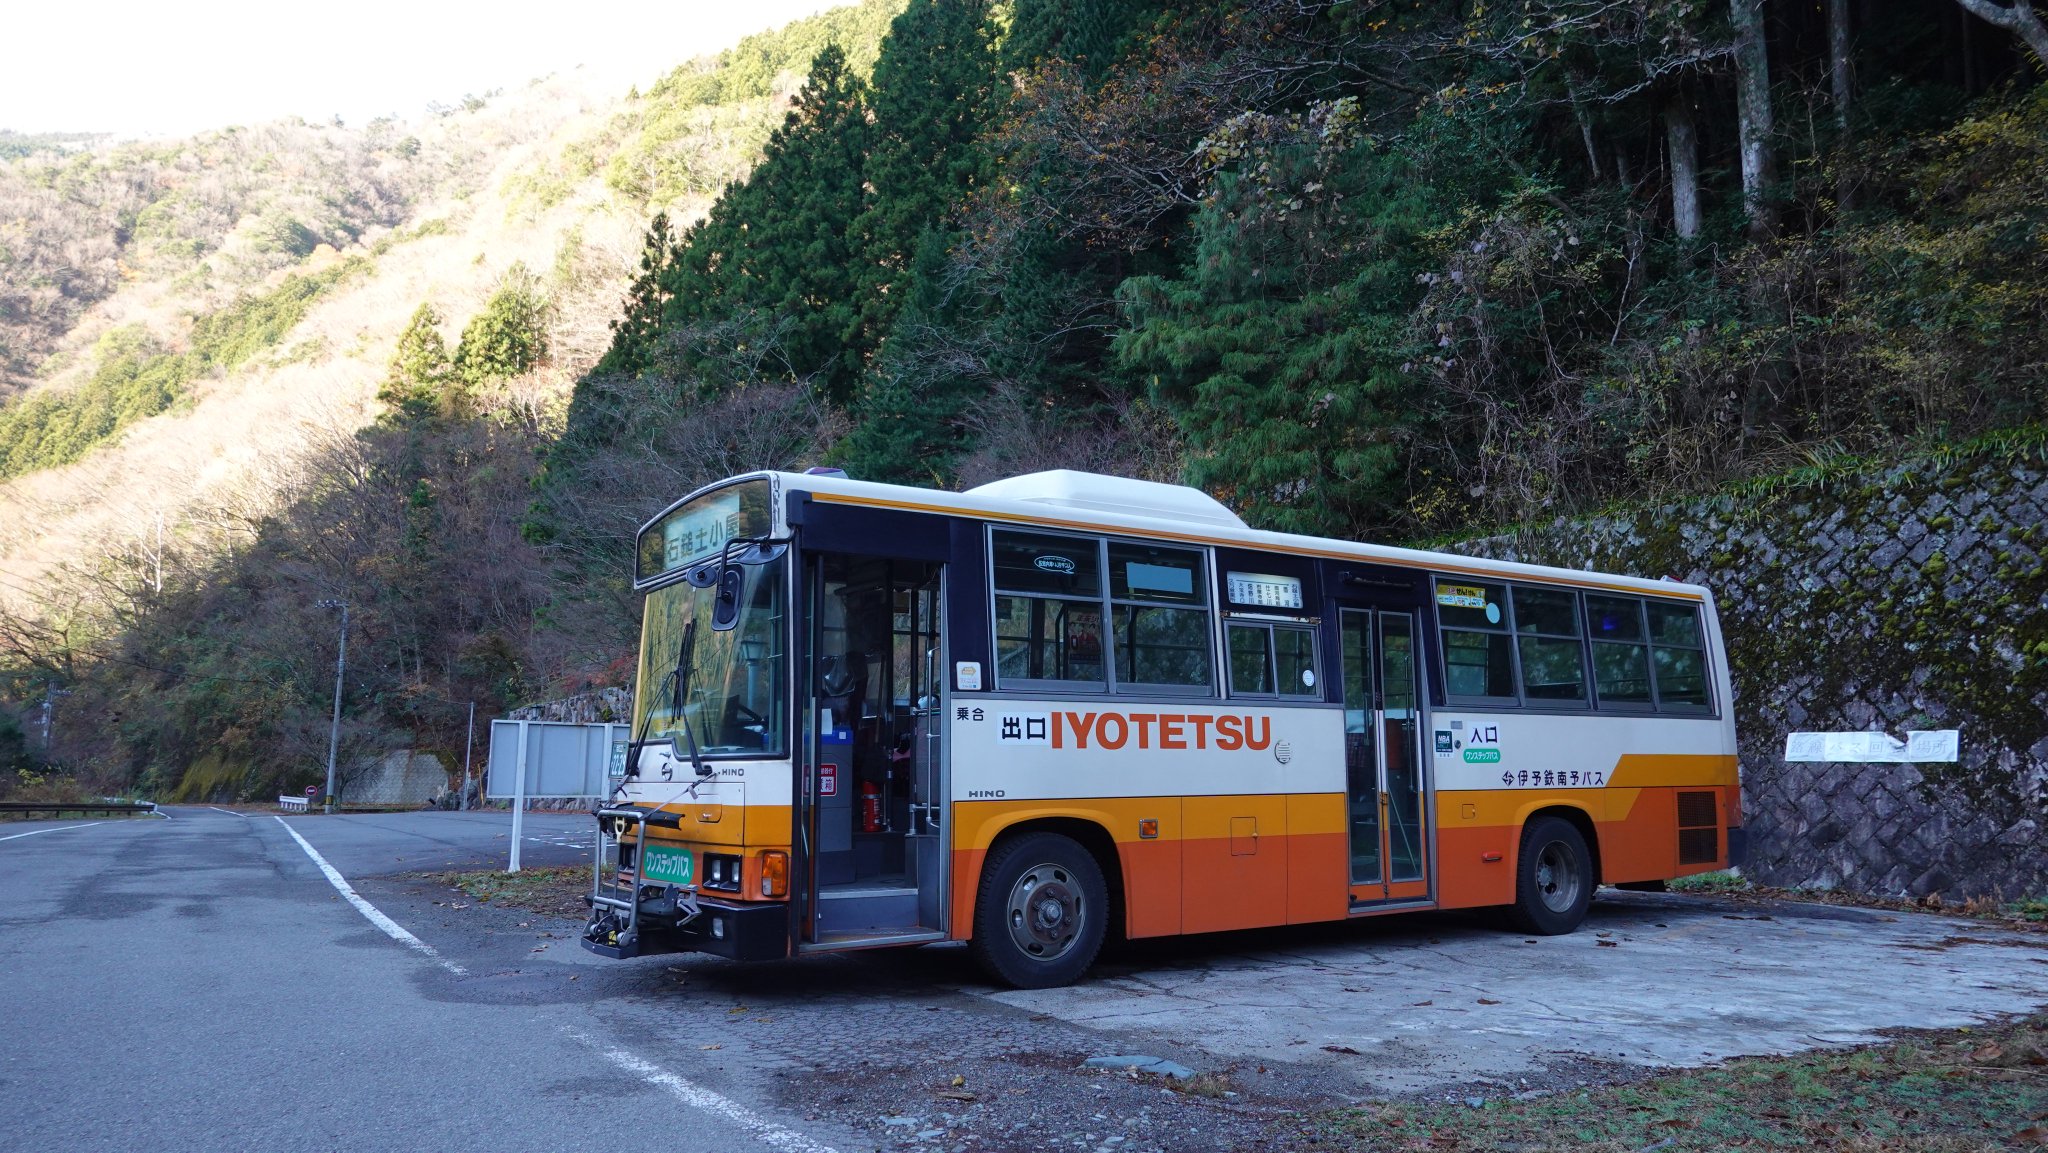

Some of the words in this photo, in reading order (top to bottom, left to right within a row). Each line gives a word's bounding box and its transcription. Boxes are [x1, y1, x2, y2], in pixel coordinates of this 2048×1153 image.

[956, 706, 985, 722] 乗合
[1001, 716, 1046, 740] 出口
[1051, 711, 1271, 750] IYOTETSU
[1471, 726, 1498, 743] 入口
[1790, 735, 1949, 754] 路線バス回場所
[1465, 751, 1499, 760] ワンステップバス
[721, 768, 745, 777] HINO
[1517, 769, 1604, 786] 伊予鉄南予バス
[968, 790, 1005, 798] HINO
[646, 850, 690, 878] ワンステップバス
